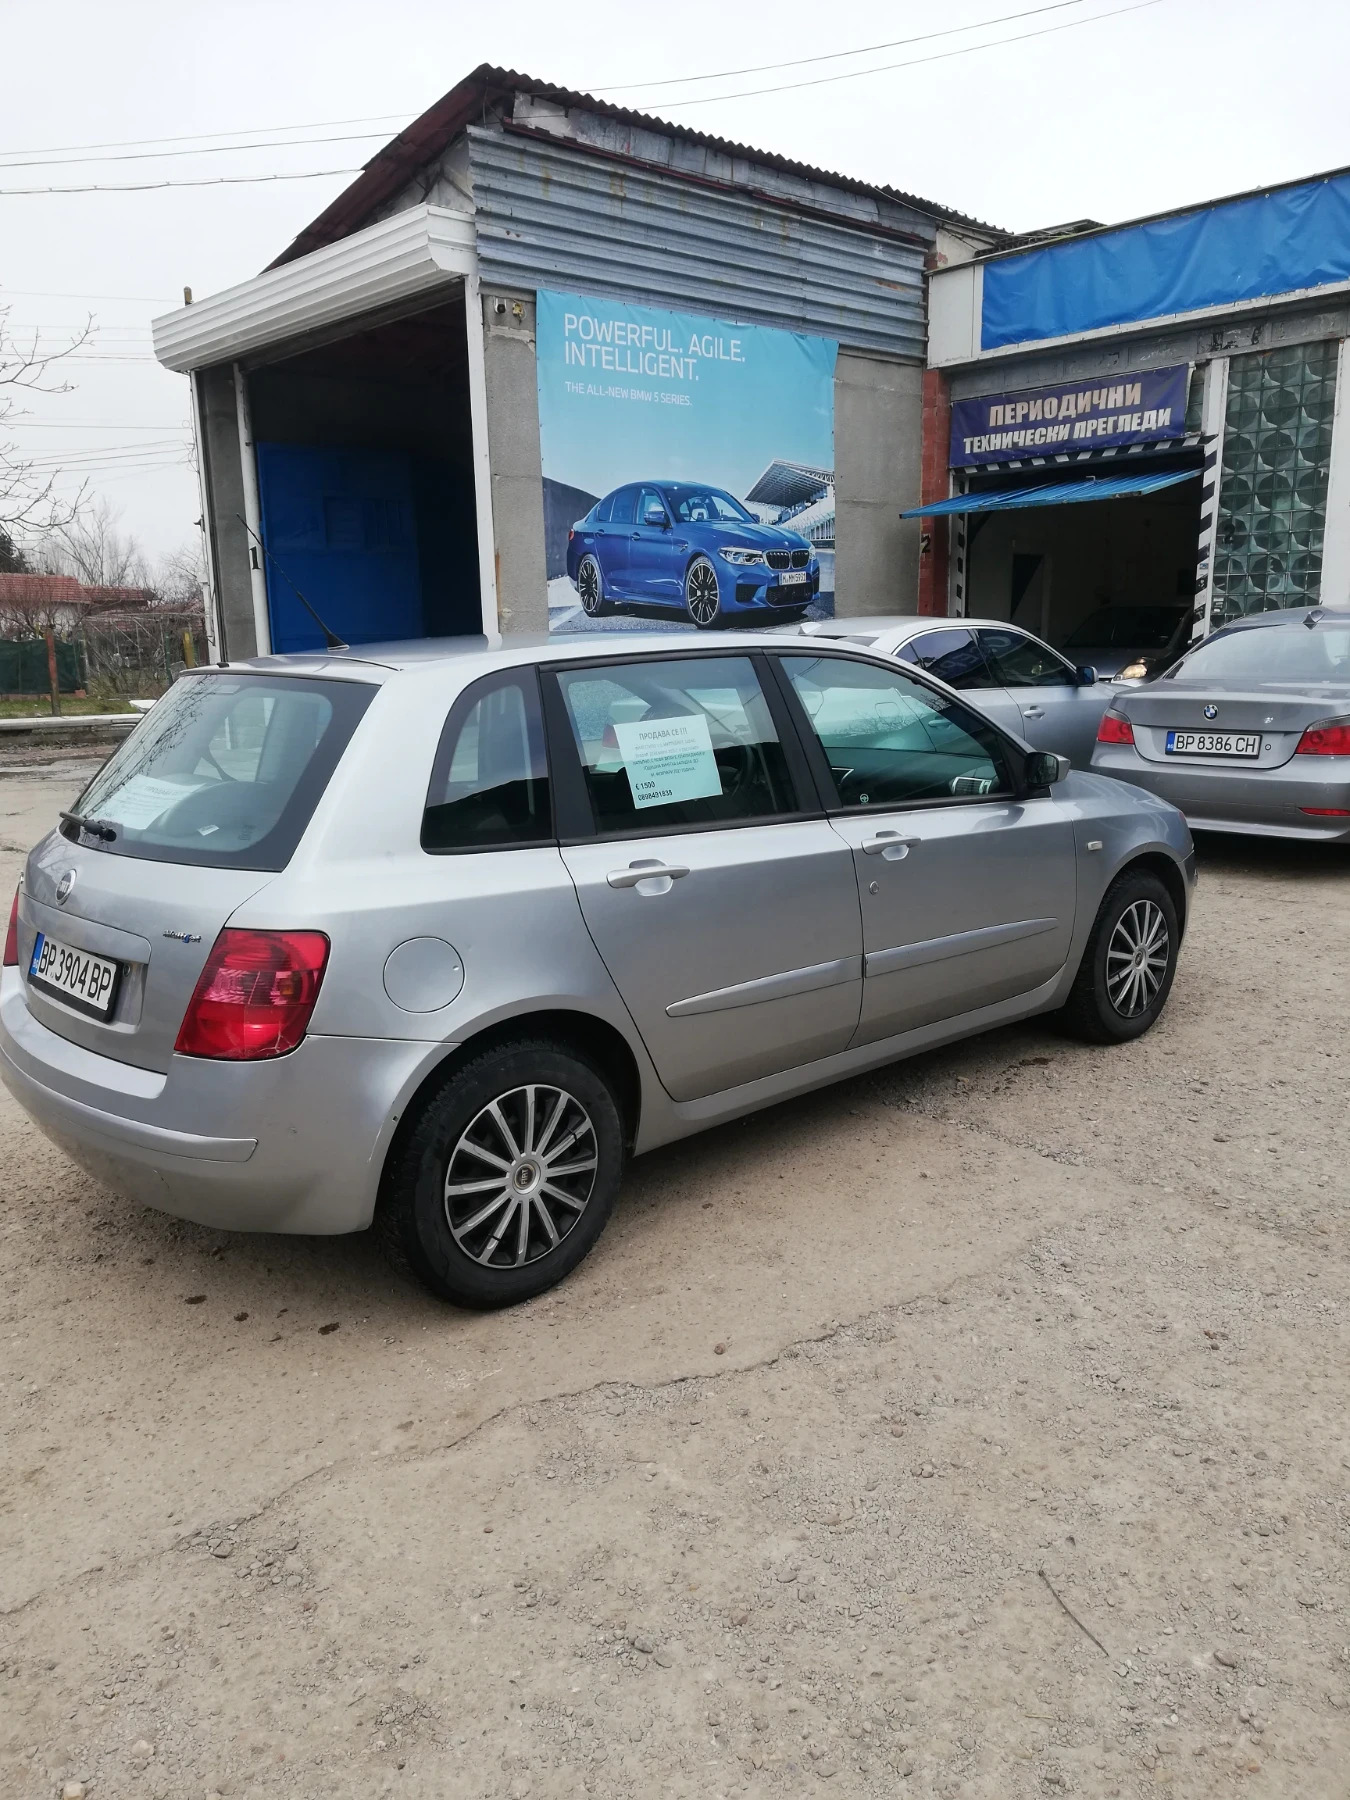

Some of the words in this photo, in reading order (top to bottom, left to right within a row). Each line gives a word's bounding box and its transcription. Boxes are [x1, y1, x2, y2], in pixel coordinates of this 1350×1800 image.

[564, 313, 683, 353] POWERFUL.
[688, 333, 746, 363] AGILE.
[564, 341, 699, 381] INTELLIGENT.
[565, 381, 585, 394] THE
[586, 384, 629, 399] ALL-NEW
[630, 389, 652, 402] BMW
[653, 391, 659, 402] 5
[660, 393, 693, 406] SERIES.
[989, 382, 1142, 427] ПЕРИОДИЧНИ
[963, 423, 1070, 454] ТЕХНИЧЕСКИ
[1073, 407, 1172, 439] ПРЕГЛЕДИ
[249, 546, 261, 570] 1
[921, 535, 931, 553] 2
[639, 729, 670, 740] ПРОДАВА
[1176, 735, 1195, 749] BP
[1197, 736, 1232, 751] 8386
[1235, 737, 1256, 753] CH
[38, 940, 57, 977] BP
[54, 948, 89, 992] 3904
[87, 963, 113, 1001] BP
